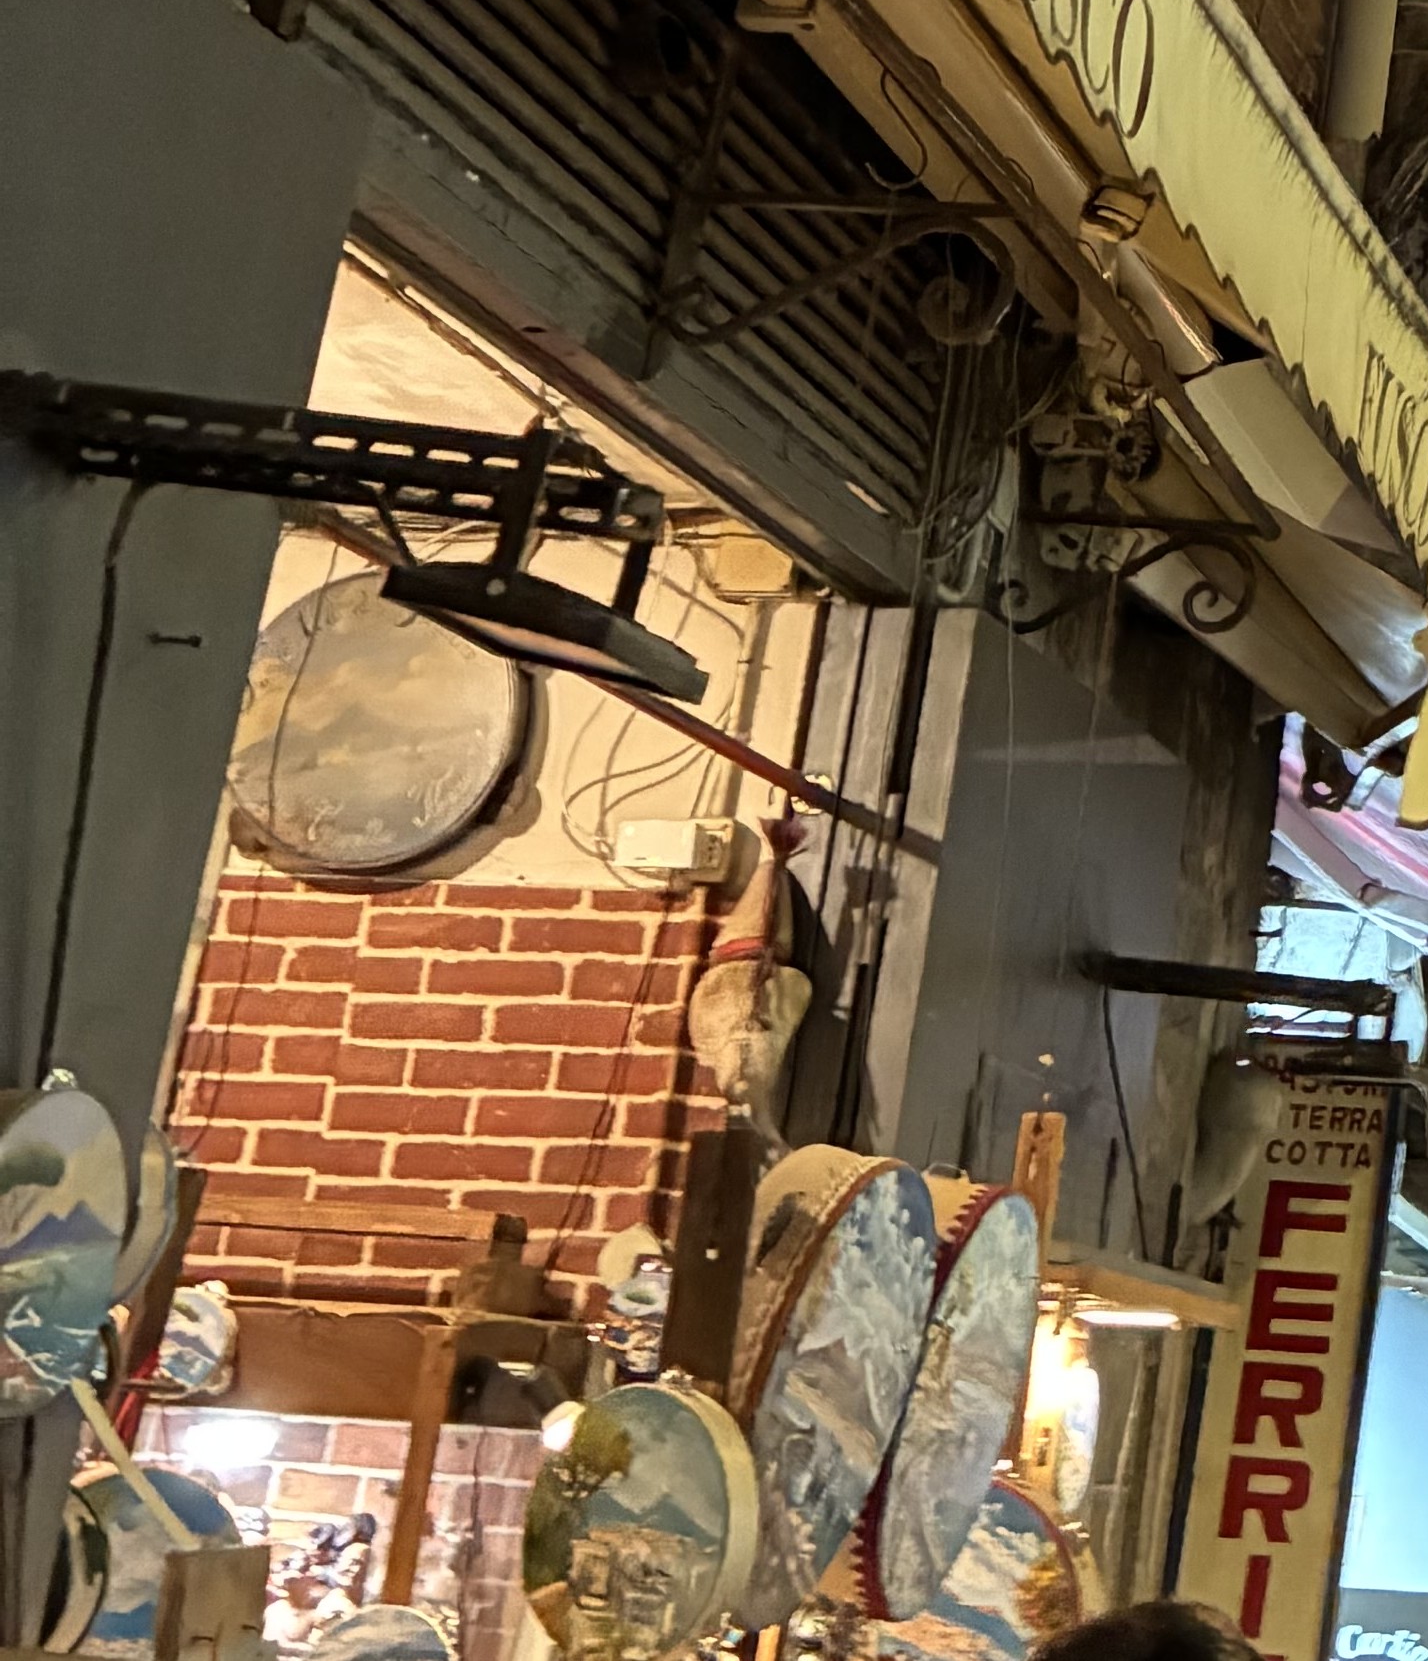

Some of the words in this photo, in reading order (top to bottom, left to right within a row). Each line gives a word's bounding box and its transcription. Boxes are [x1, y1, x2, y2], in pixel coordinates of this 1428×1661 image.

[1289, 1103, 1383, 1135] TERRA
[1266, 1139, 1372, 1169] COTTA
[1217, 1180, 1353, 1661] FERRI
